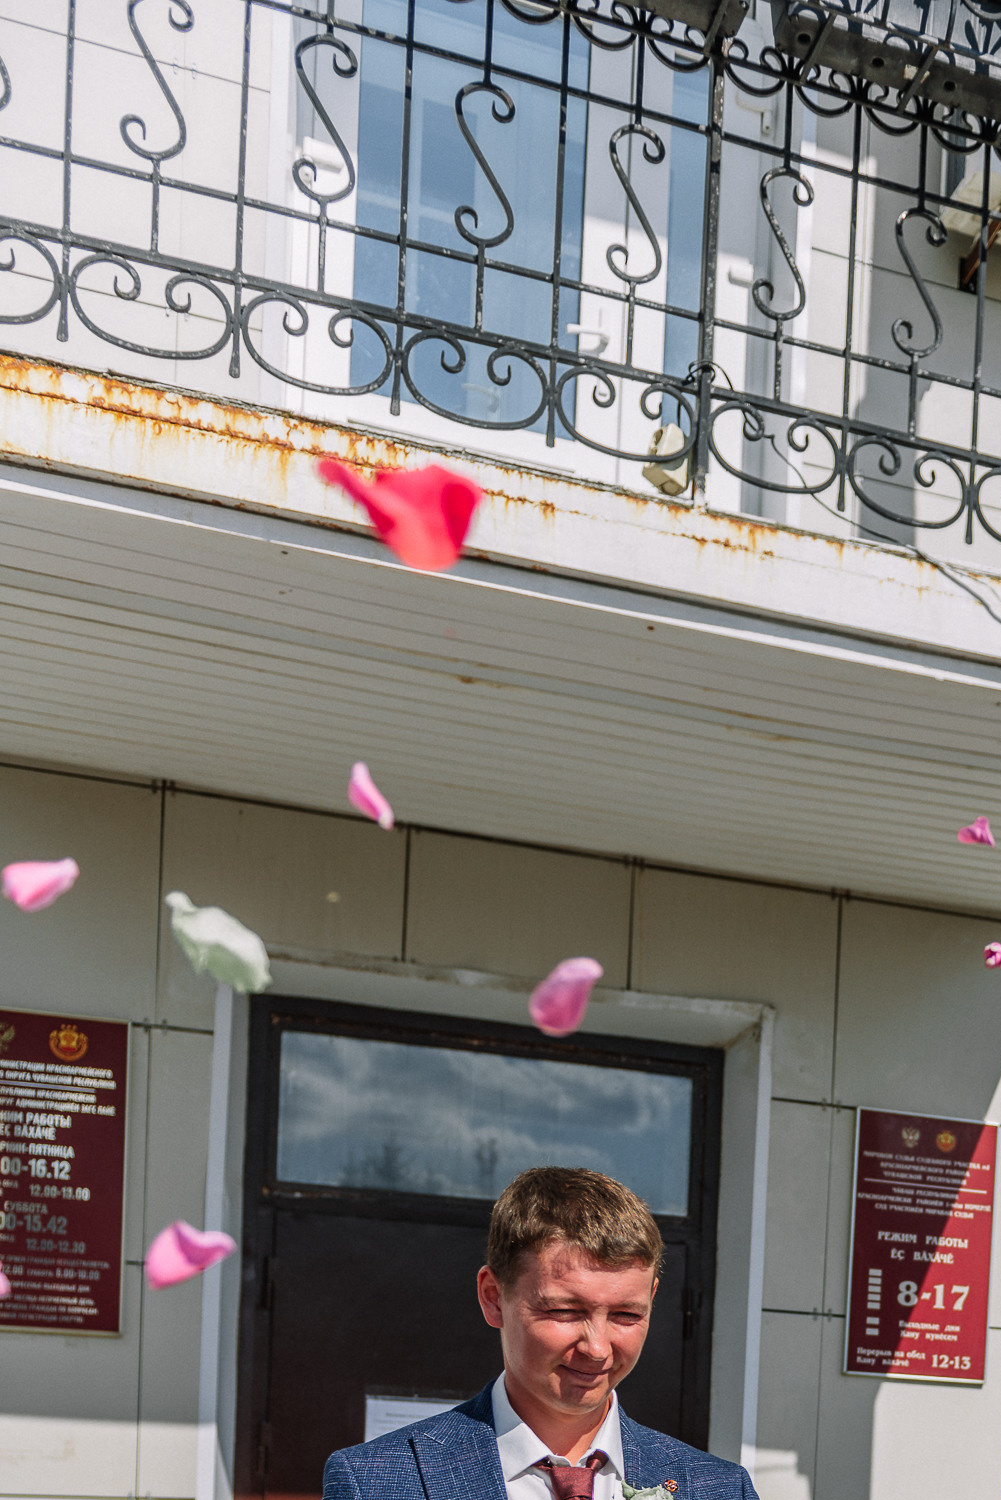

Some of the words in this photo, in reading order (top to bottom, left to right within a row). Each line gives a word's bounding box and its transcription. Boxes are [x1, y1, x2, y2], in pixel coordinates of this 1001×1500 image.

[25, 1111, 72, 1129] РАБОТЫ
[4, 1200, 48, 1215] СУББОТА
[878, 1230, 917, 1243] РЕЖИМ
[925, 1235, 969, 1249] РАБОТЫ
[896, 1280, 970, 1311] 8-17
[898, 1320, 940, 1330] Выходные
[900, 1330, 920, 1340] Кану
[857, 1346, 892, 1357] Перерыв
[906, 1349, 926, 1360] обед
[856, 1356, 876, 1366] Кану
